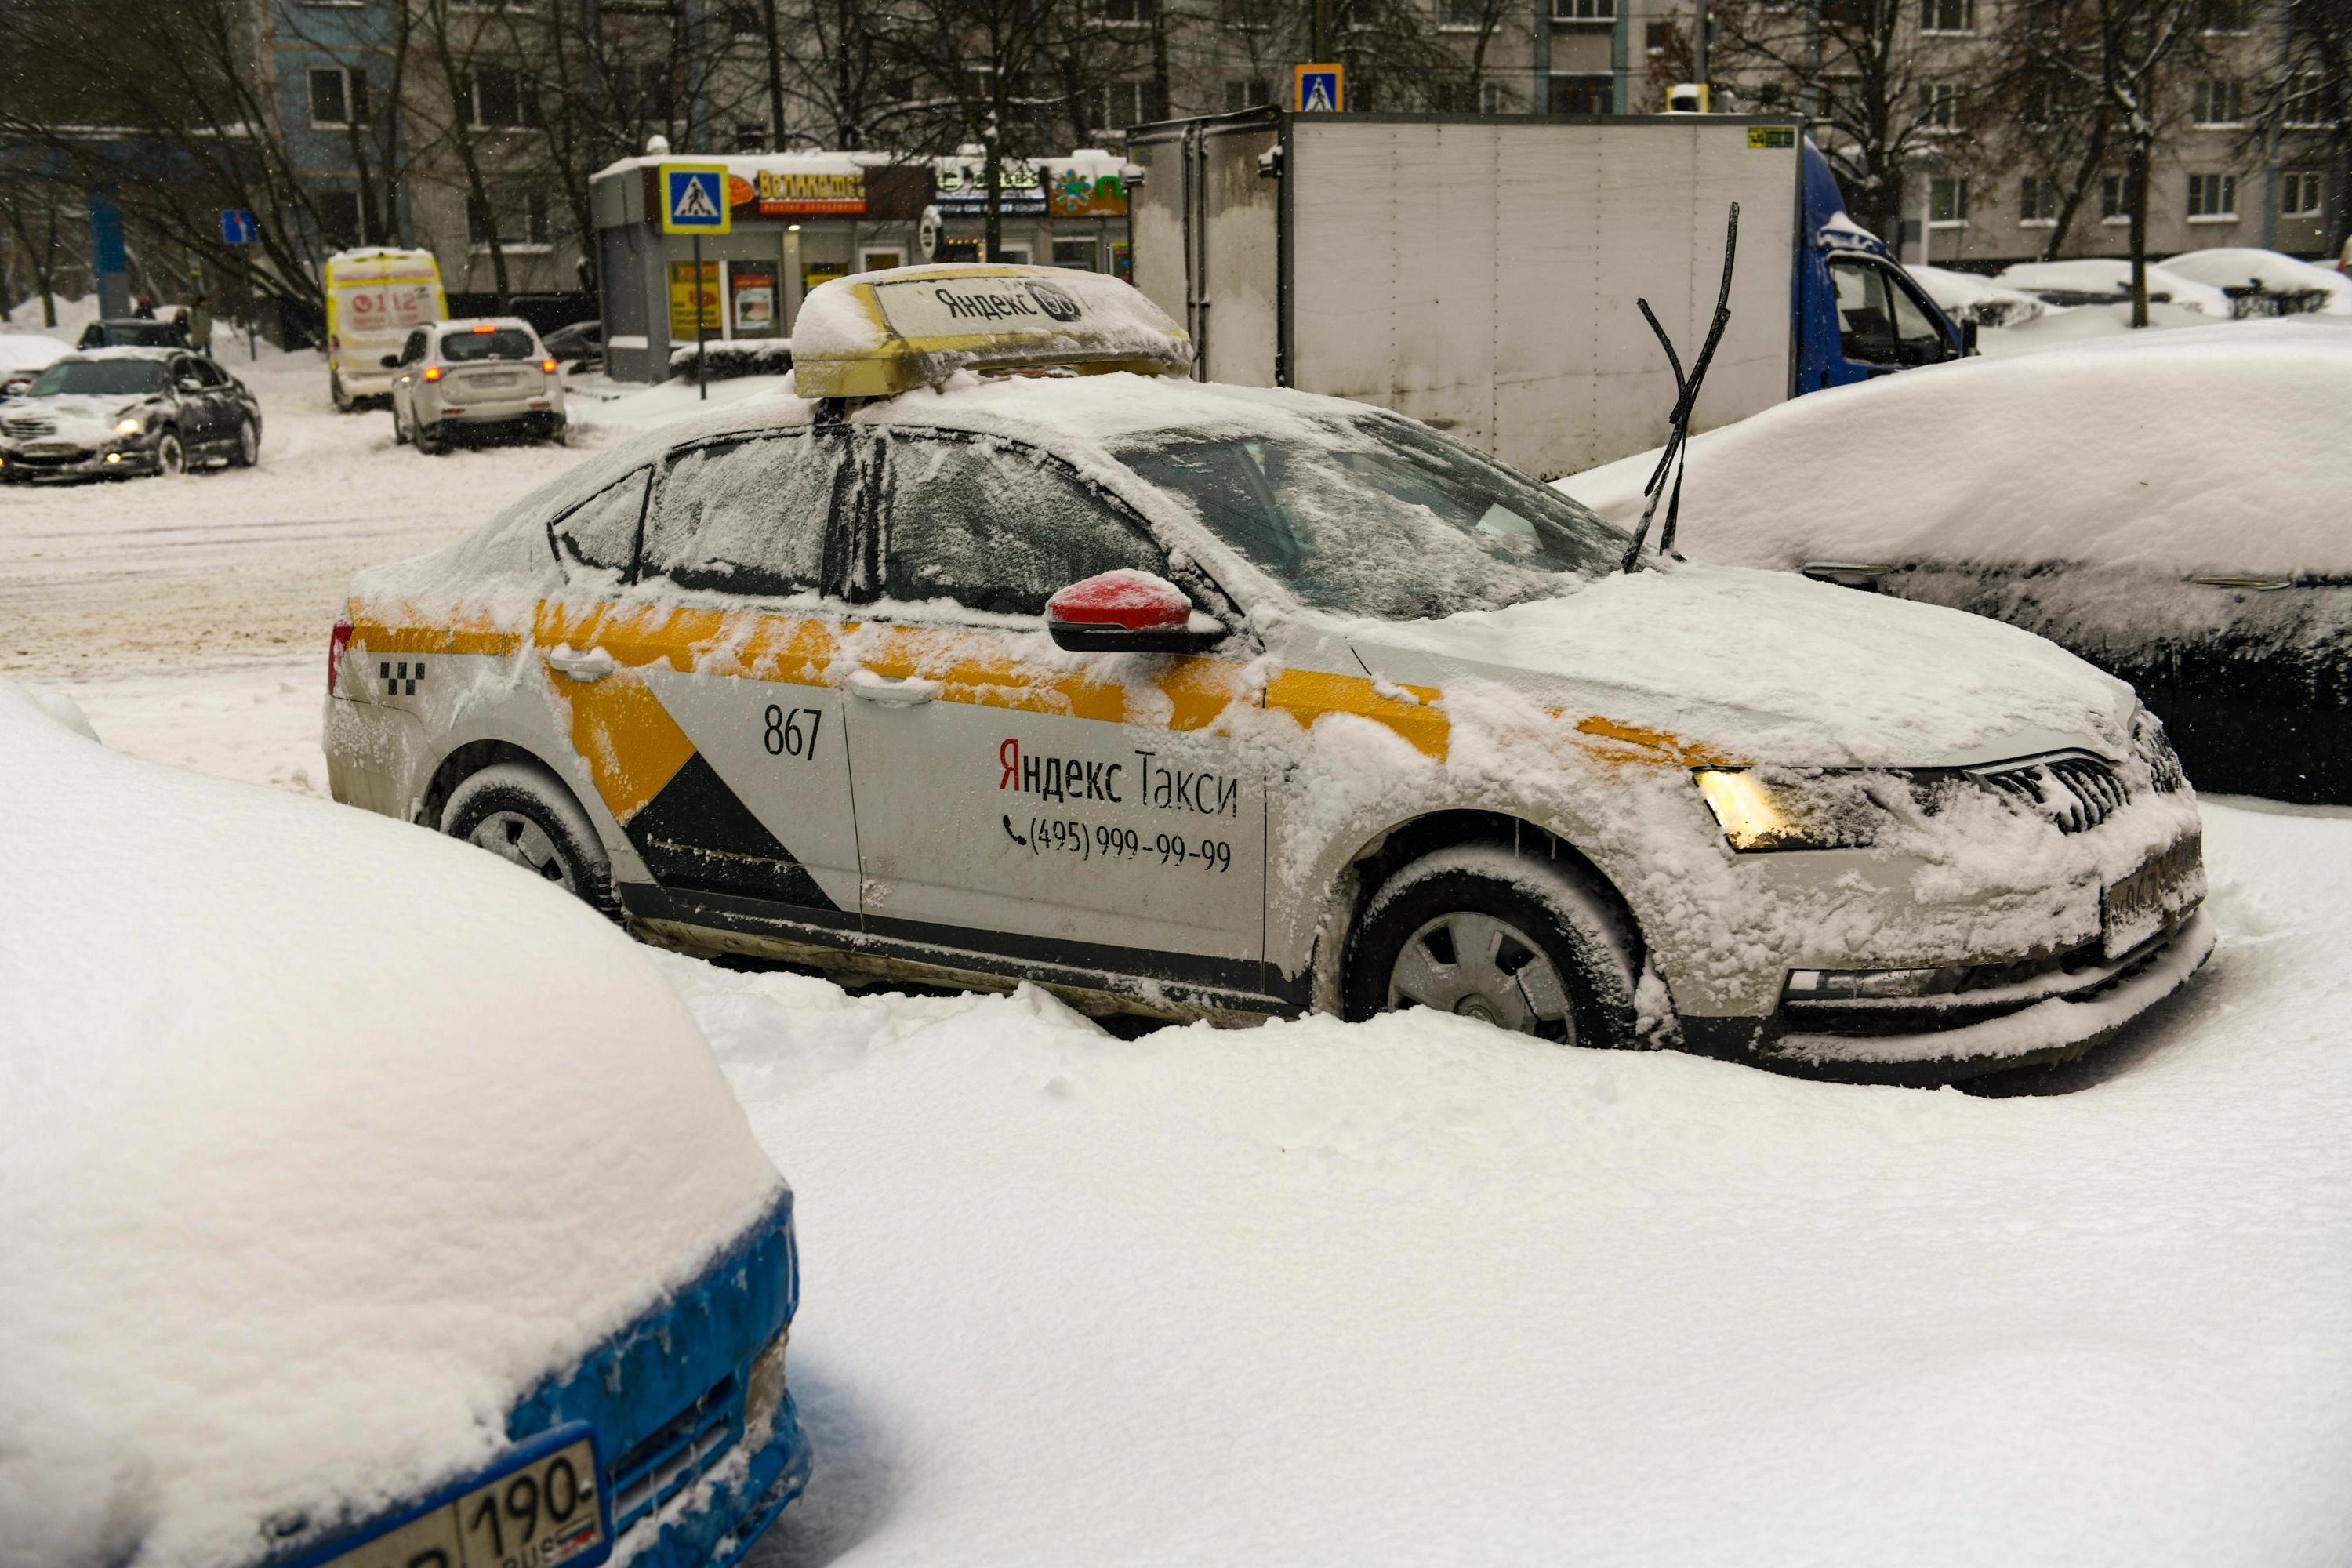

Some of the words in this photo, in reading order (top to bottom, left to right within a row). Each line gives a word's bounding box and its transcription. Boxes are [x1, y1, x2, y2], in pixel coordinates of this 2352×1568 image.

[935, 288, 1038, 321] Яндекс
[764, 704, 822, 760] 867
[999, 739, 1123, 804] Яндекс
[1134, 750, 1238, 818] Такси
[1030, 817, 1091, 861] (495)
[1096, 826, 1232, 873] 999-99-99
[470, 1457, 577, 1559] 190
